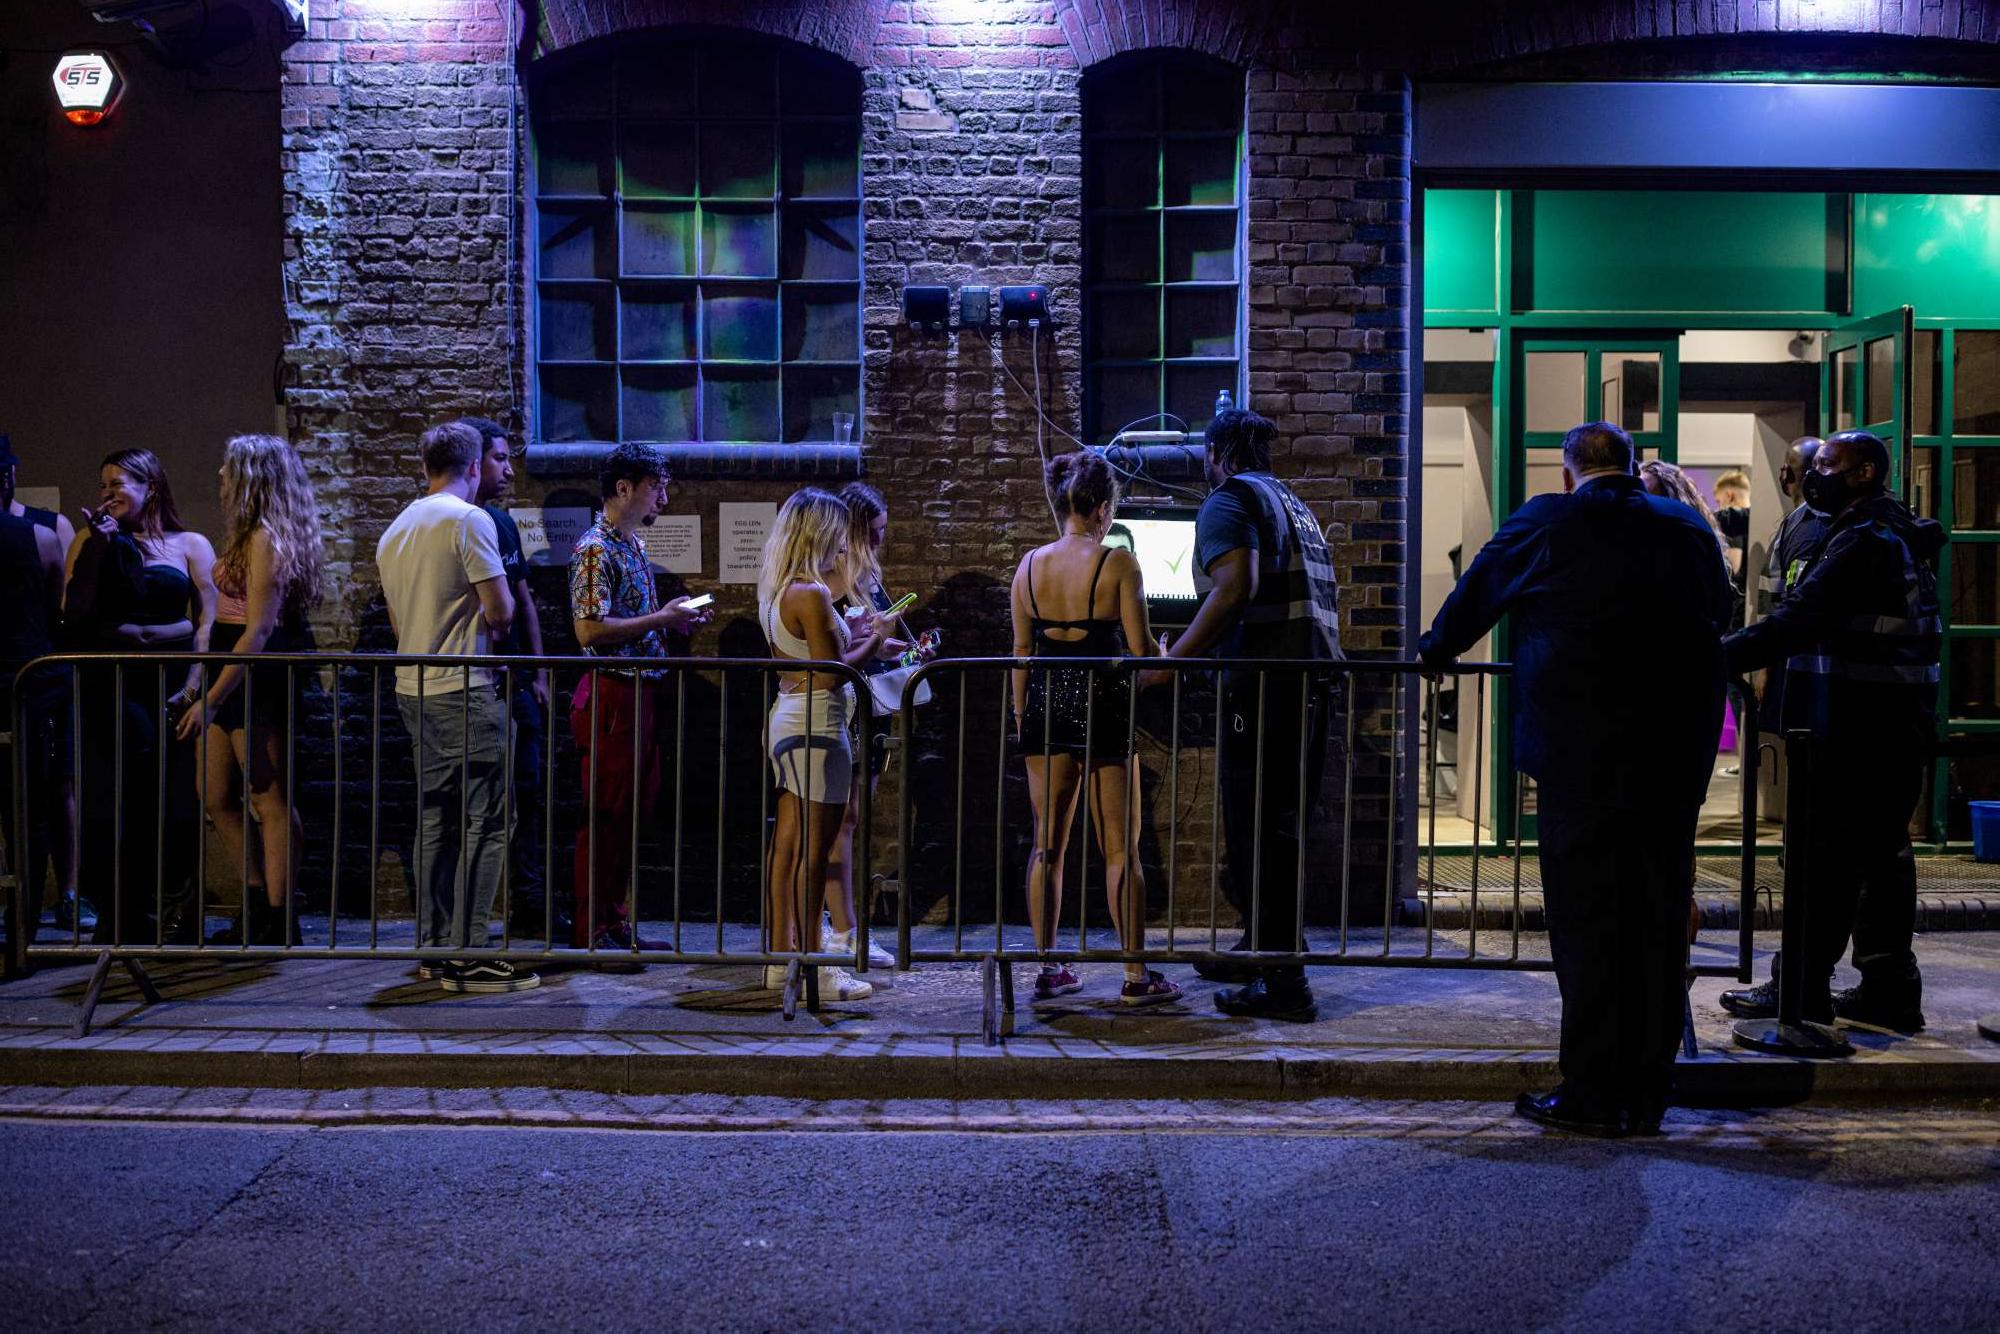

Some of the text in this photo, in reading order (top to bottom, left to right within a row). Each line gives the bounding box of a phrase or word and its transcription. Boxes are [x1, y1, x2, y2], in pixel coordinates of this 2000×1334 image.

[67, 67, 101, 85] STS
[519, 517, 576, 528] No Search
[528, 532, 575, 543] No Entry
